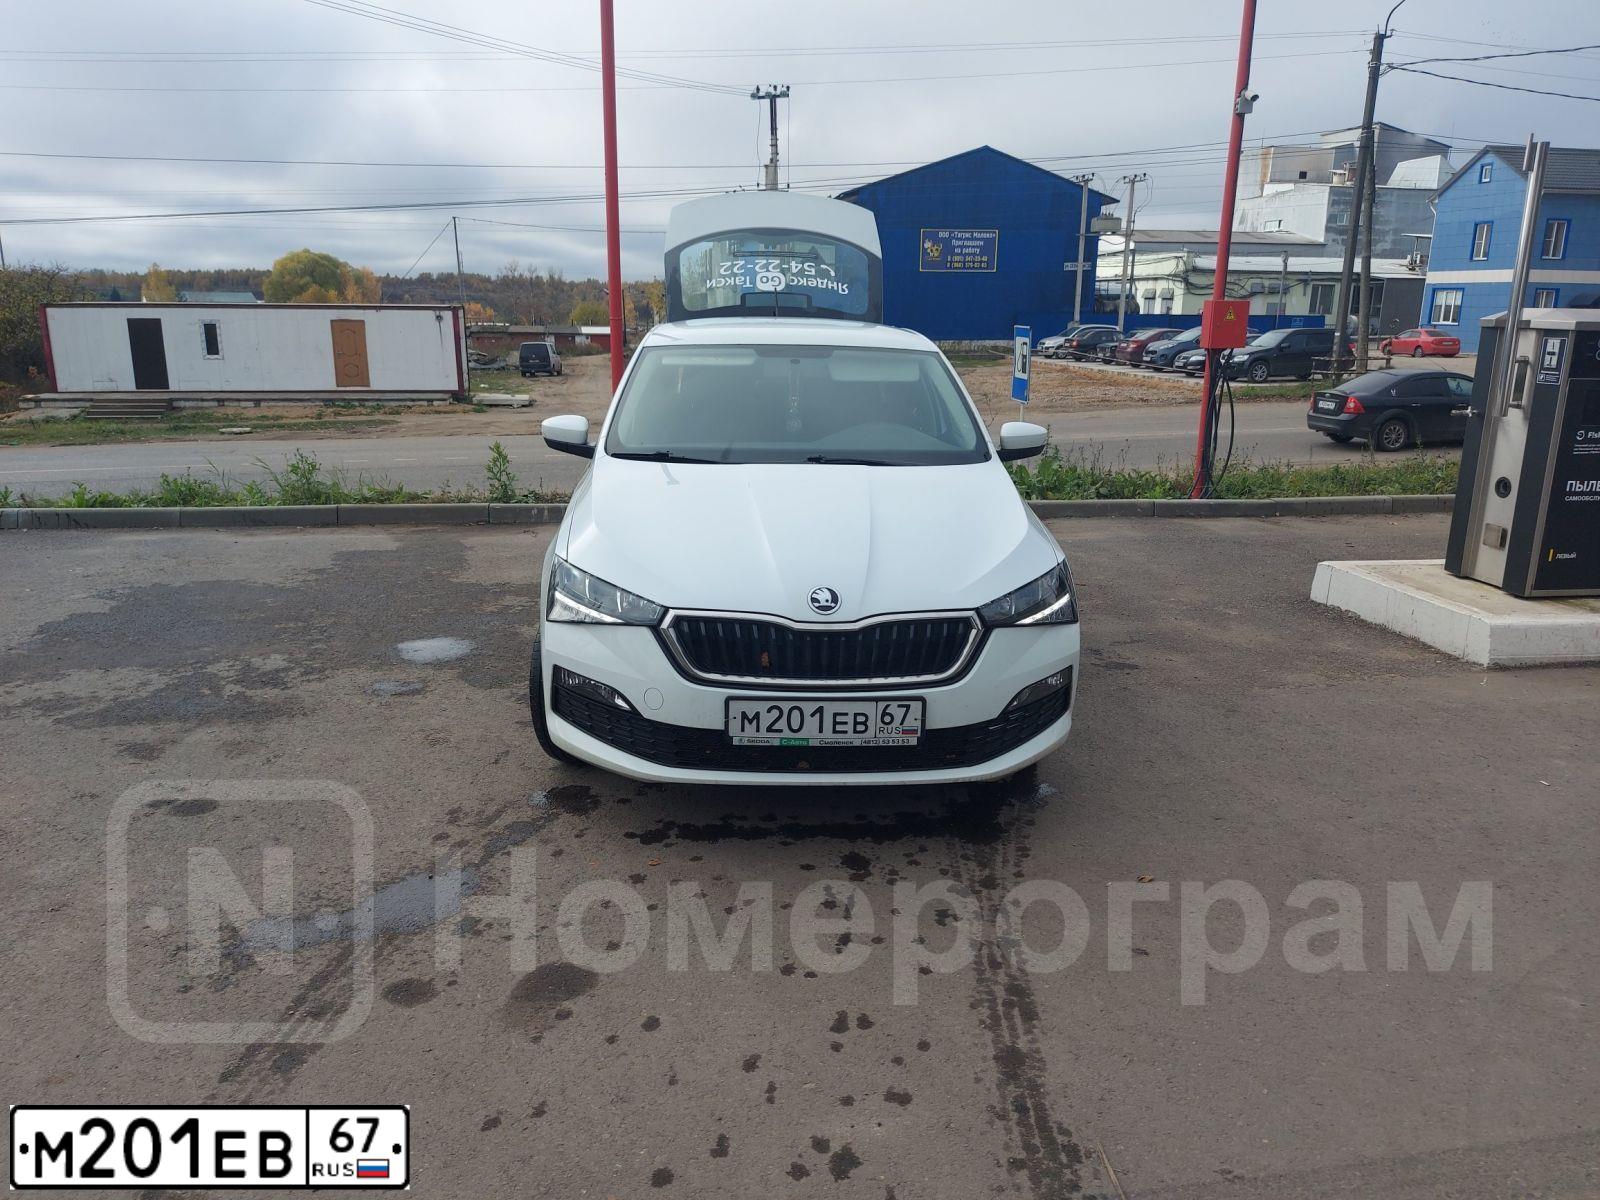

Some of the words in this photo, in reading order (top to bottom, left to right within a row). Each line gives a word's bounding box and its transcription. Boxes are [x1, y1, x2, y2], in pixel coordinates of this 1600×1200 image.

[720, 260, 816, 274] 54-22-22
[706, 276, 753, 288] Такси
[758, 274, 783, 288] Go
[789, 276, 848, 295] Яндекс
[740, 705, 869, 734] М201ЕВ
[880, 704, 911, 726] 67
[878, 726, 900, 734] RUS
